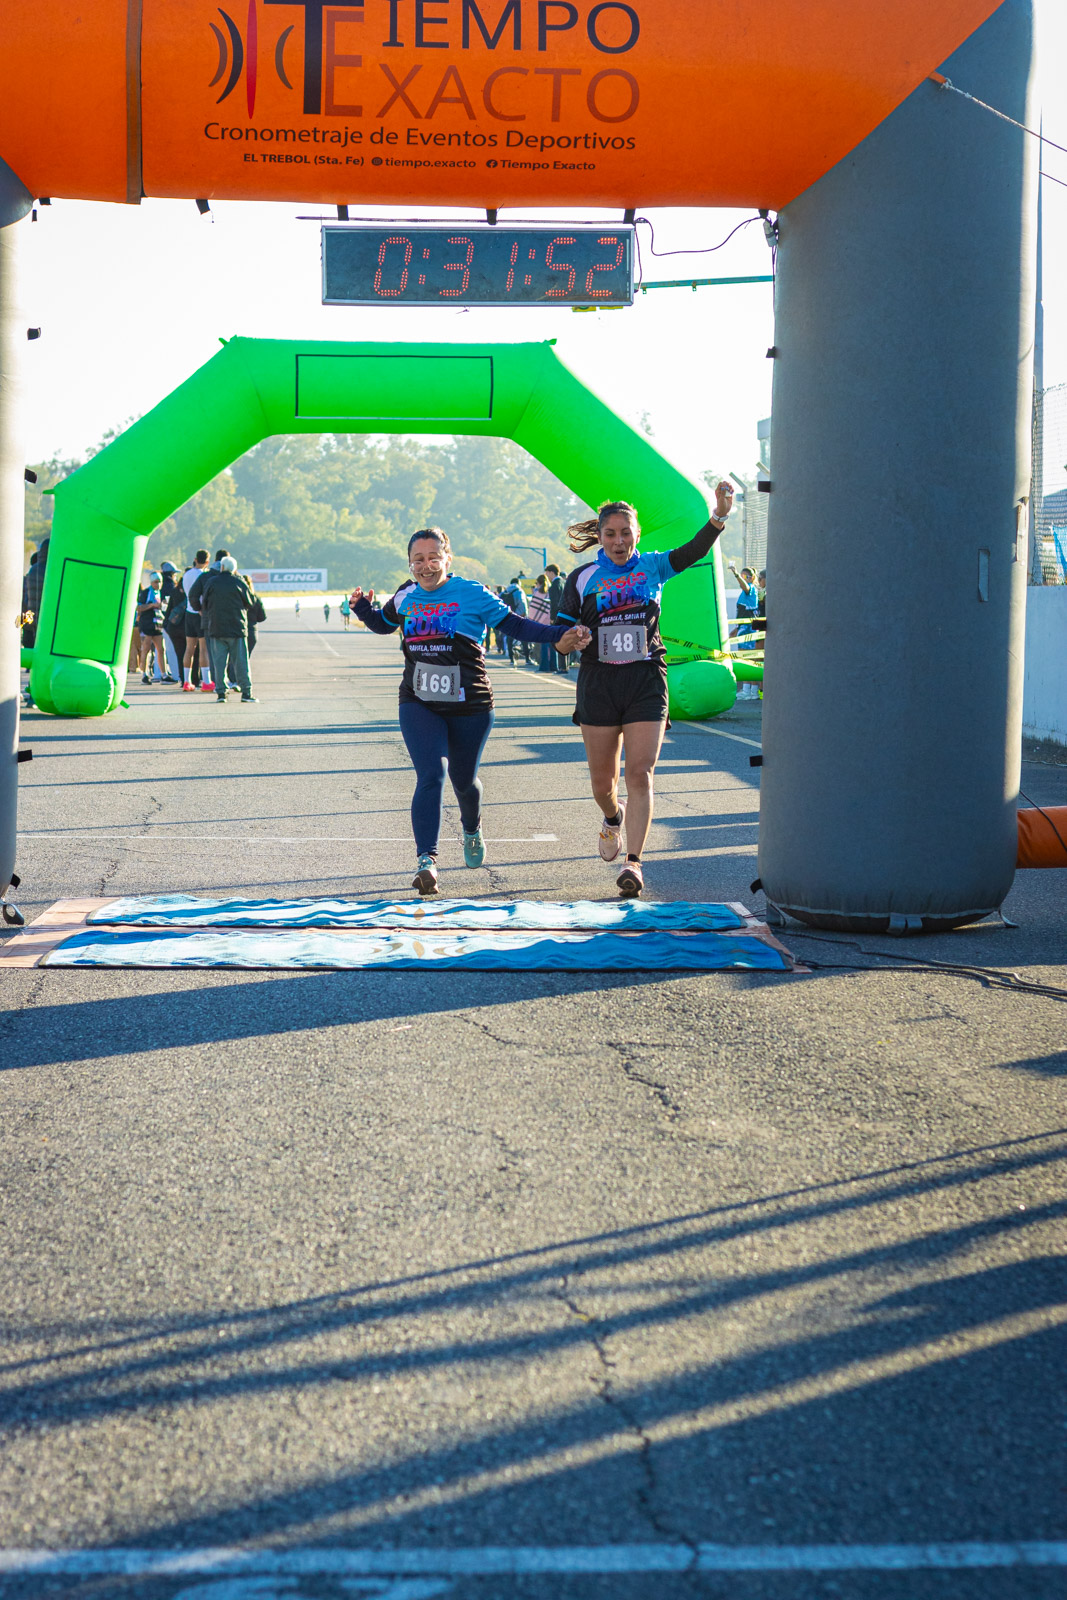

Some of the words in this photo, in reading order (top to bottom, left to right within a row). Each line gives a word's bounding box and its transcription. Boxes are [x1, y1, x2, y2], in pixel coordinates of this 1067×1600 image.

[203, 121, 363, 148] Cronometraje
[369, 126, 398, 146] de
[406, 127, 498, 148] Eventos
[506, 129, 636, 153] Deportivos
[243, 153, 259, 163] EL
[260, 154, 311, 165] TREBOL
[313, 155, 343, 166] (Sta.
[346, 155, 365, 167] Fe)
[384, 156, 476, 171] tiempo.exacto
[500, 158, 549, 172] Tiempo
[552, 160, 596, 171] Exacto
[273, 573, 318, 582] LONG
[430, 644, 446, 652] SANTA
[612, 632, 634, 652] 48
[420, 672, 451, 694] 169
